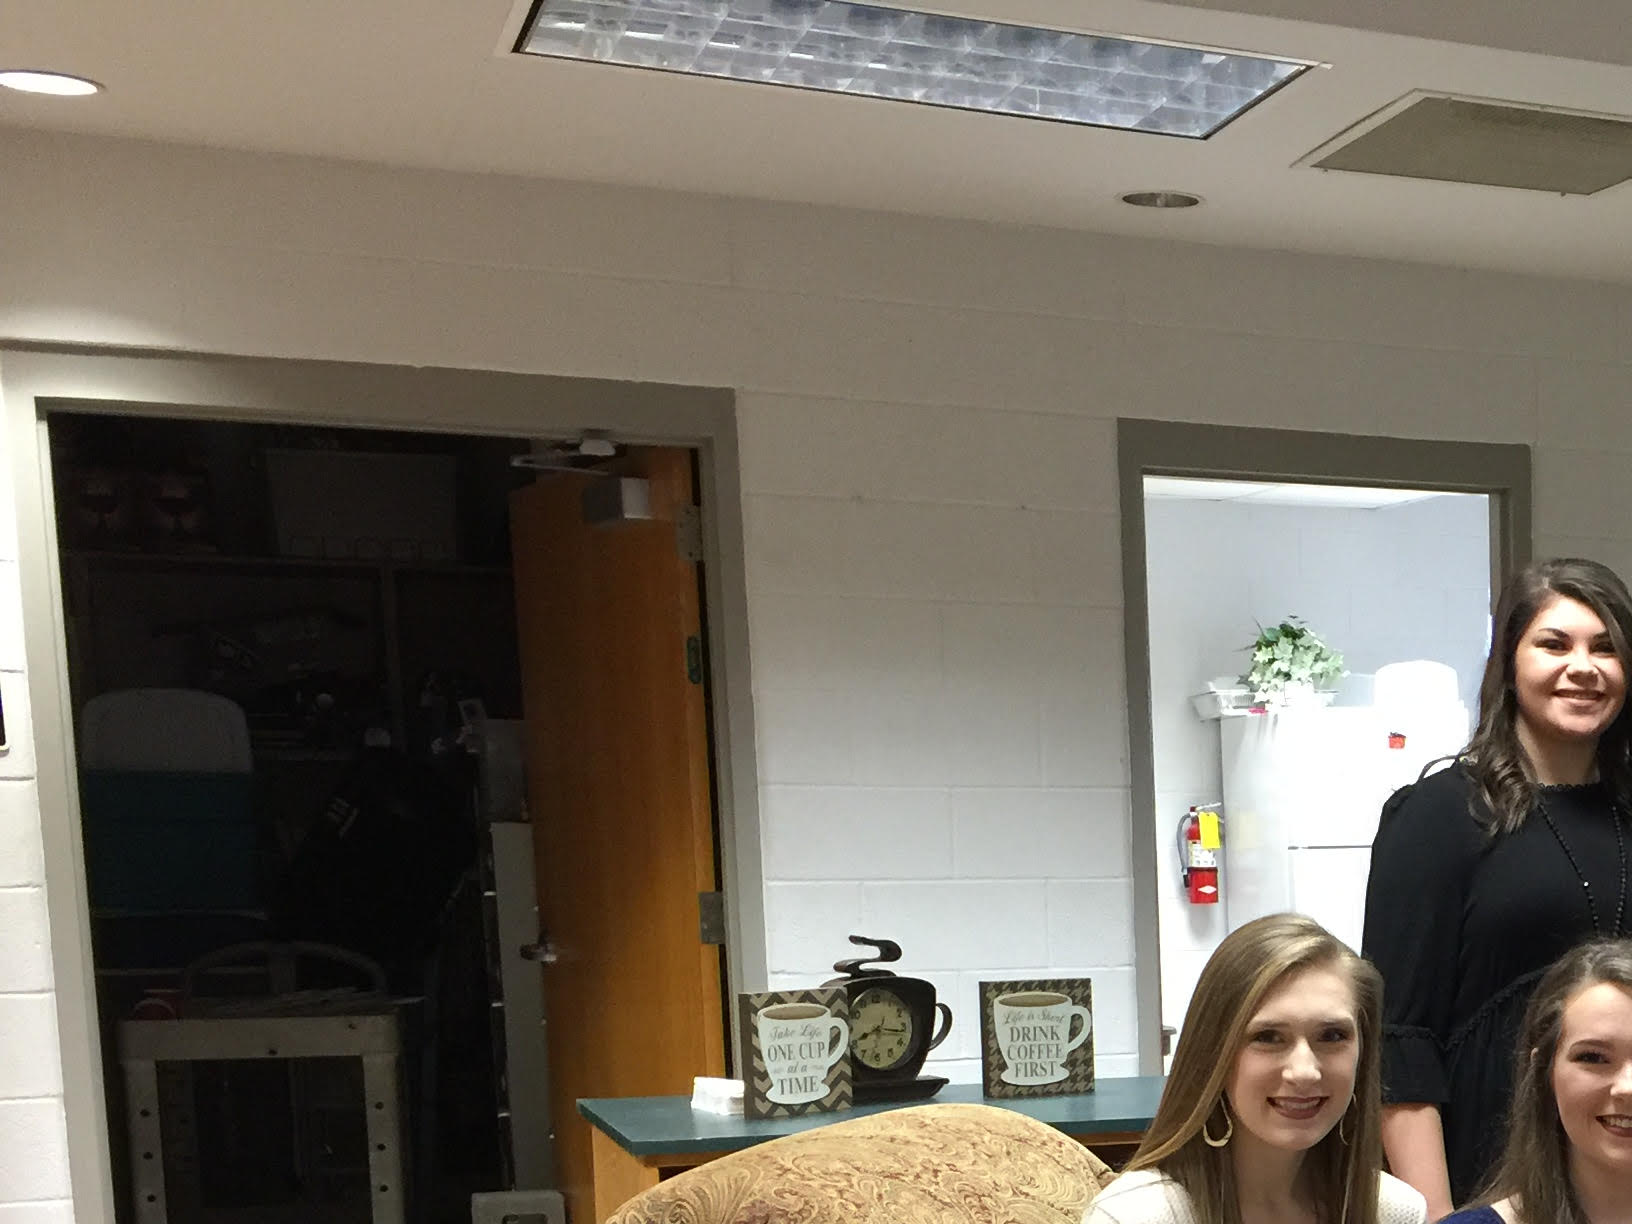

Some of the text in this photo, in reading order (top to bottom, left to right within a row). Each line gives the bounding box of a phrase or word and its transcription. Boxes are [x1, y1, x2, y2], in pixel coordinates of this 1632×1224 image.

[1003, 1009, 1024, 1025] Life
[769, 1023, 823, 1040] Take Life
[1010, 1025, 1061, 1043] DRINK
[767, 1041, 825, 1063] ONE CUP
[1007, 1043, 1065, 1061] COFFEE
[786, 1062, 808, 1074] at a
[1014, 1060, 1058, 1078] FIRST
[777, 1075, 820, 1096] TIME
